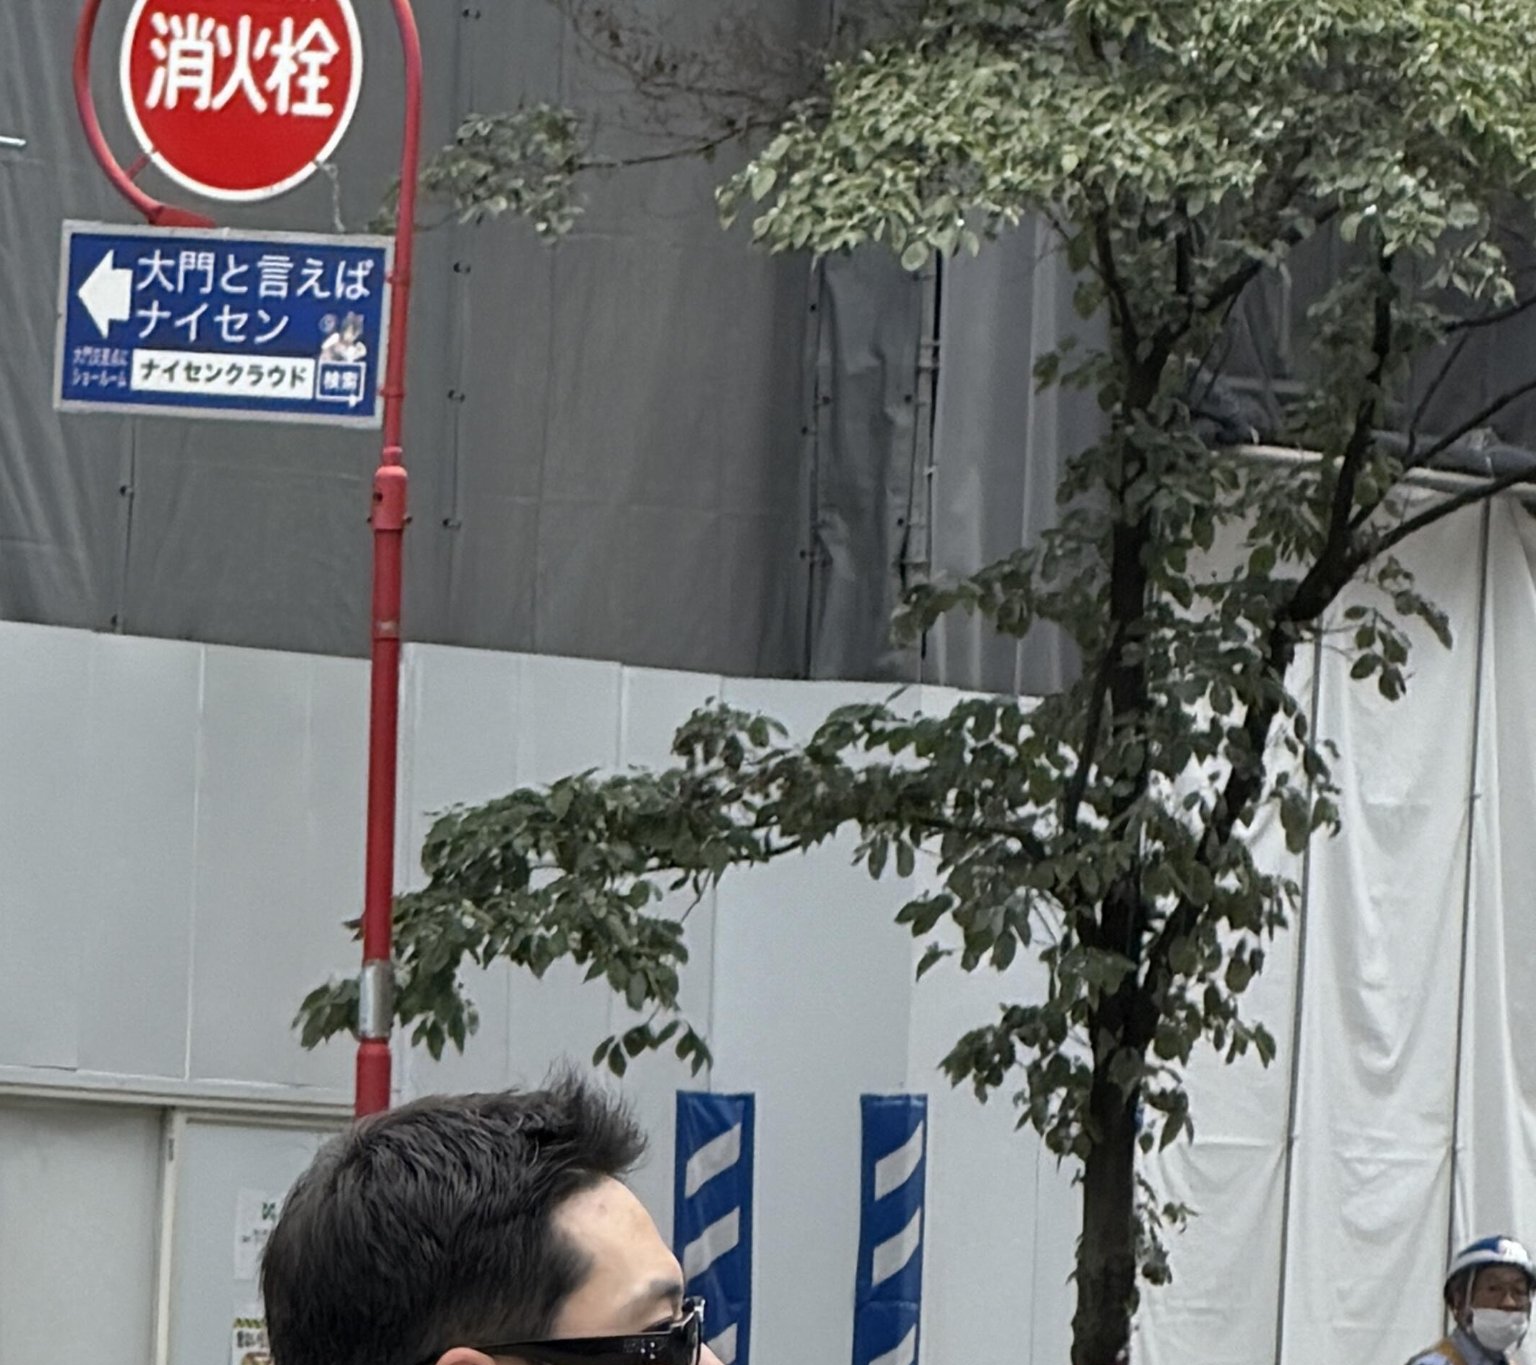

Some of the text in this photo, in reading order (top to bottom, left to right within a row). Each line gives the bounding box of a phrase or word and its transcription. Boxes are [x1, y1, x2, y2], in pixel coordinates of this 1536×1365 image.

[145, 12, 340, 118] 消火栓
[135, 247, 375, 301] 大門と言えば
[135, 300, 290, 345] ナイセン
[139, 358, 307, 387] ナイセンクラウド
